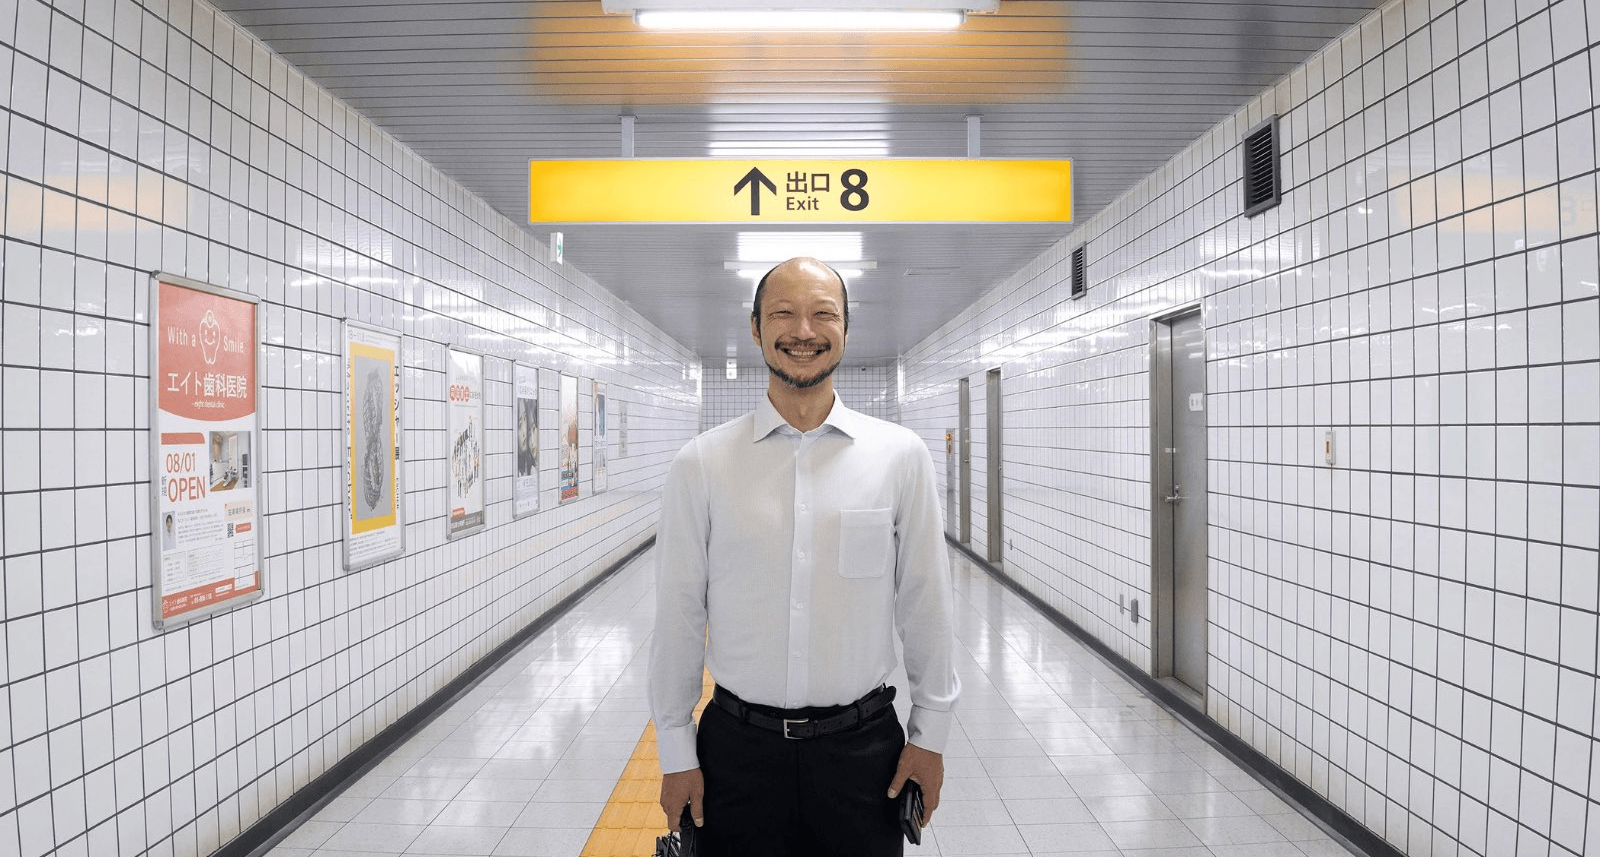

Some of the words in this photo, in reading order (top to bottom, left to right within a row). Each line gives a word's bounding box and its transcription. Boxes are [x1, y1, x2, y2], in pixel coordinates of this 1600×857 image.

[787, 171, 830, 194] 出口
[840, 168, 870, 212] 8
[787, 196, 820, 211] Exit
[167, 326, 188, 346] With
[192, 334, 196, 347] a
[223, 335, 244, 354] Smile
[167, 371, 248, 399] エイト歯科医院
[166, 452, 196, 474] 08/01
[168, 475, 206, 503] OPEN
